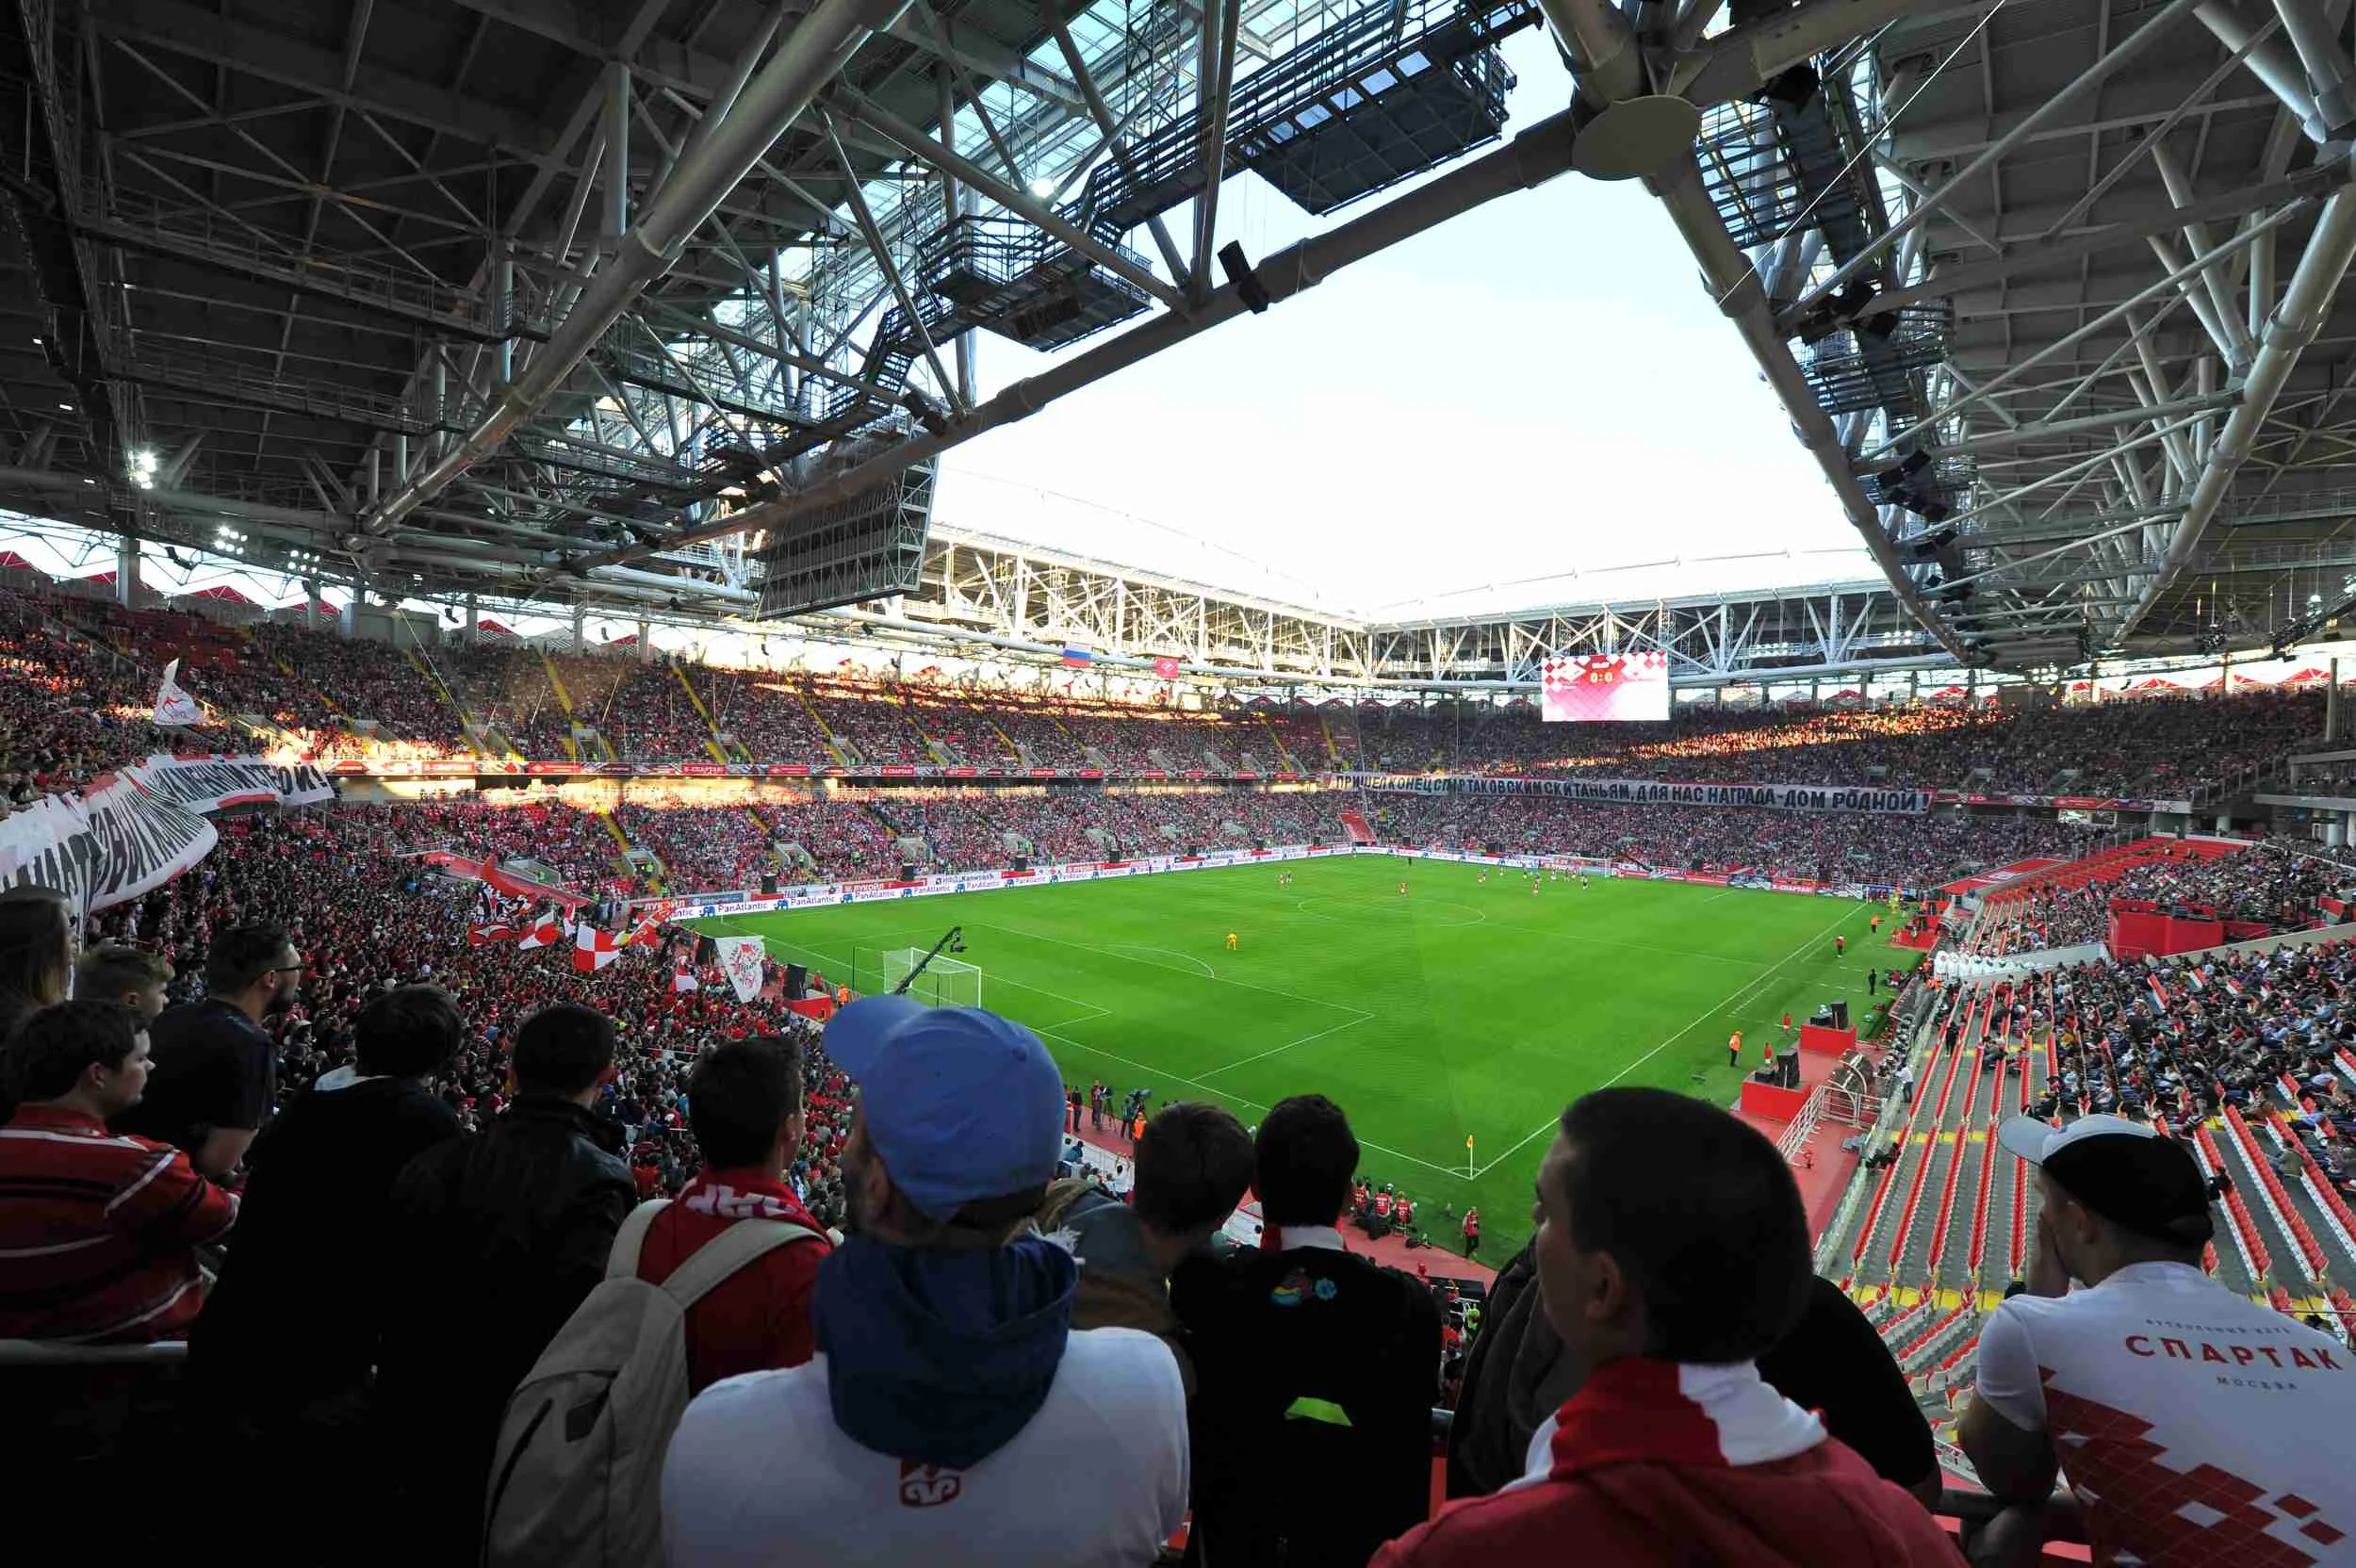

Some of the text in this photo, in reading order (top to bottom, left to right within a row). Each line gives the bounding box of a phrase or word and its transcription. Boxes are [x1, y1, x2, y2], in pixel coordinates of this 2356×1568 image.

[1590, 672, 1613, 683] 0:0
[1388, 776, 1432, 792] КОНЕЦ
[1433, 778, 1542, 795] СПАРТАКОВСКИМ
[1544, 781, 1634, 800] СКИТАНЬЯМ,
[1636, 785, 1669, 802] ДЛЯ
[1671, 786, 1704, 802] НАС
[644, 898, 687, 912] ЛУЙЛ
[718, 902, 769, 913] PanAtlantic
[791, 896, 837, 906] PanAtlantic
[2125, 1334, 2344, 1371] СПАРТАК
[2217, 1376, 2299, 1391] МОСКВА
